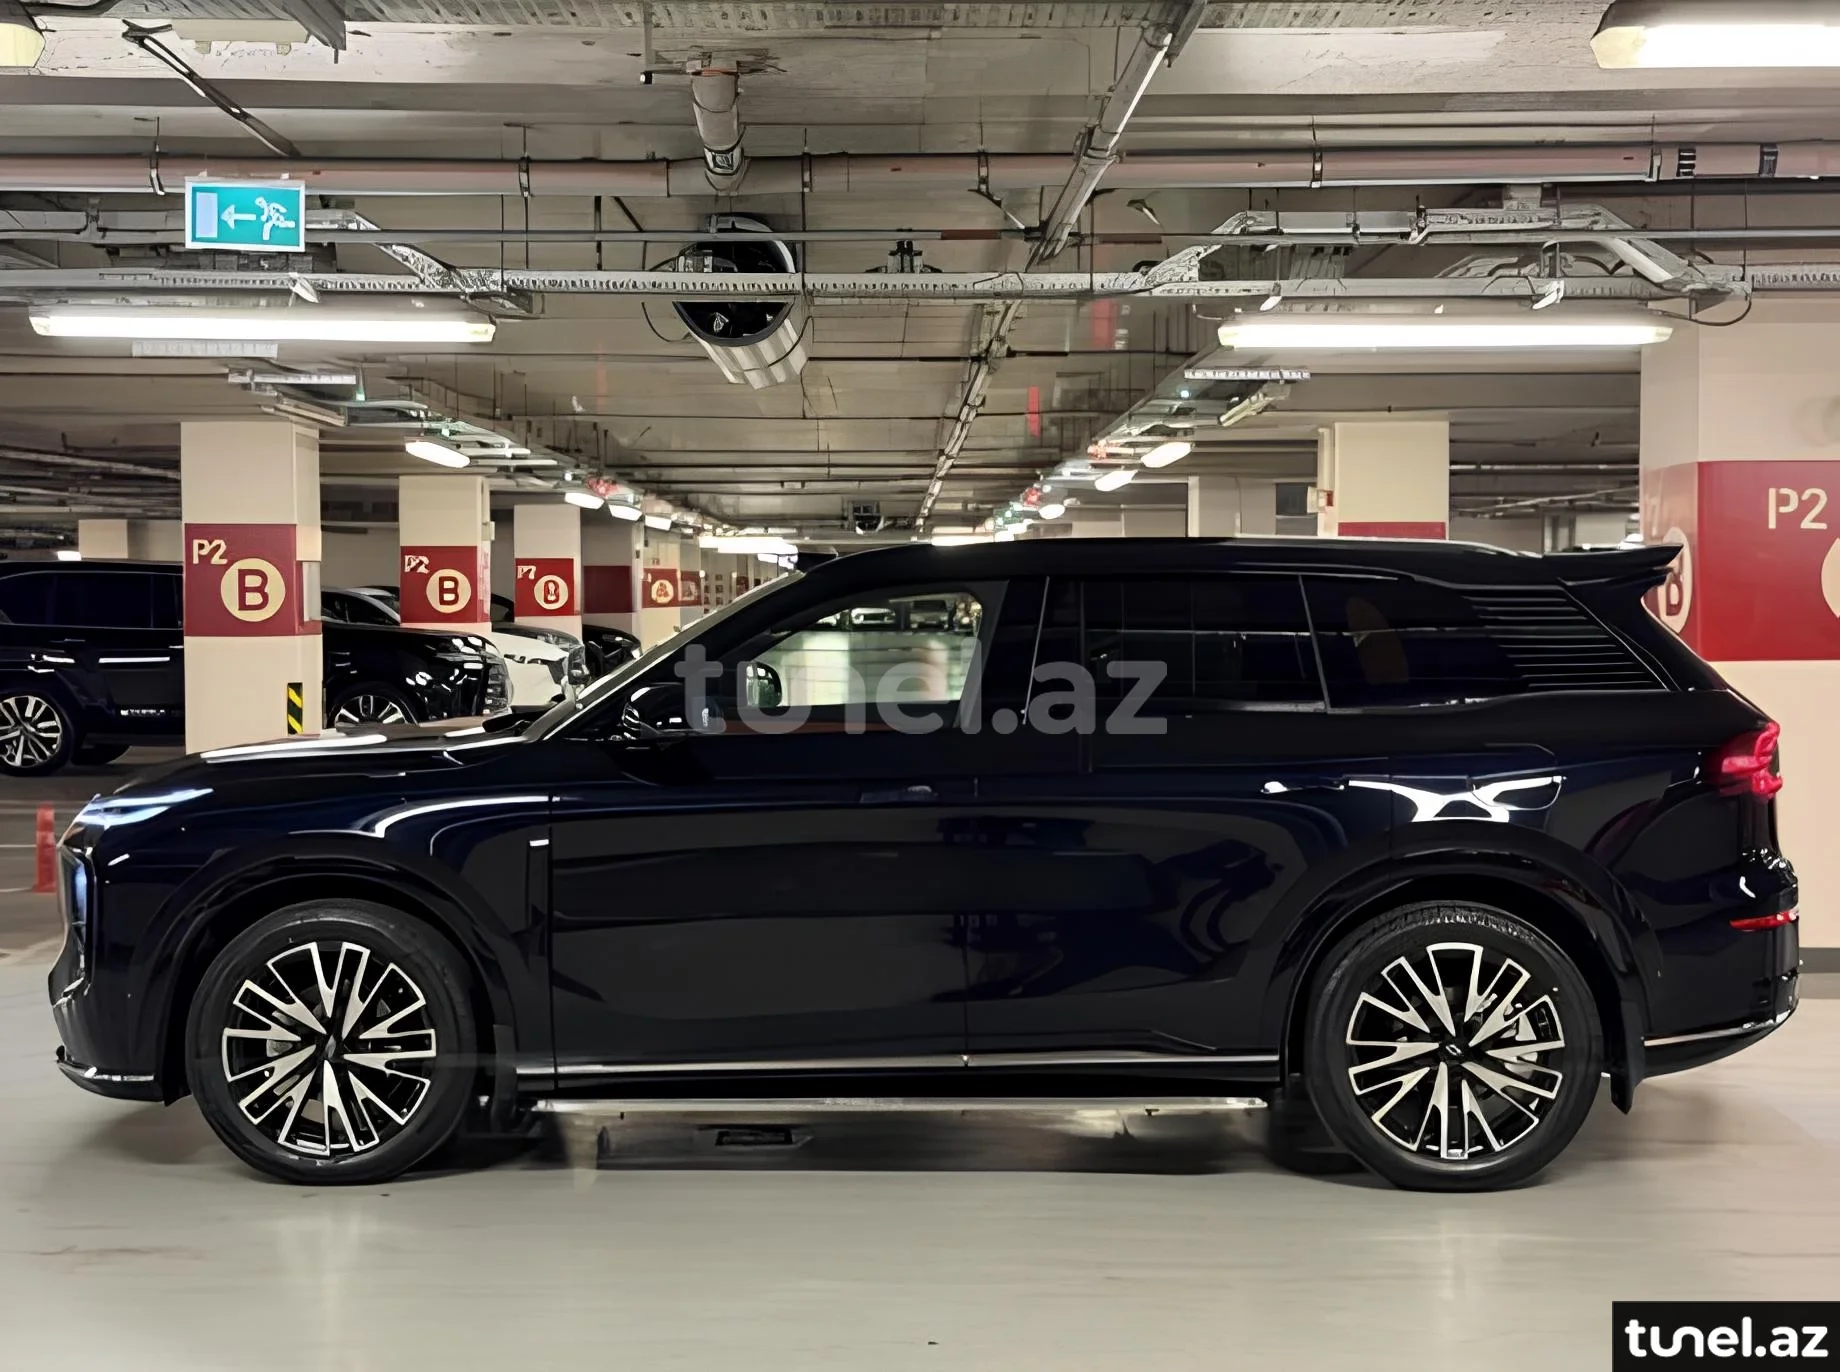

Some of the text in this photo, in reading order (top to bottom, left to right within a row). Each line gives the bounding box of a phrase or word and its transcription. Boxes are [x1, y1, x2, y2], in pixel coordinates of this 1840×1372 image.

[1768, 487, 1828, 530] P2
[192, 539, 228, 565] P2
[237, 568, 269, 611] B
[439, 576, 459, 606] B
